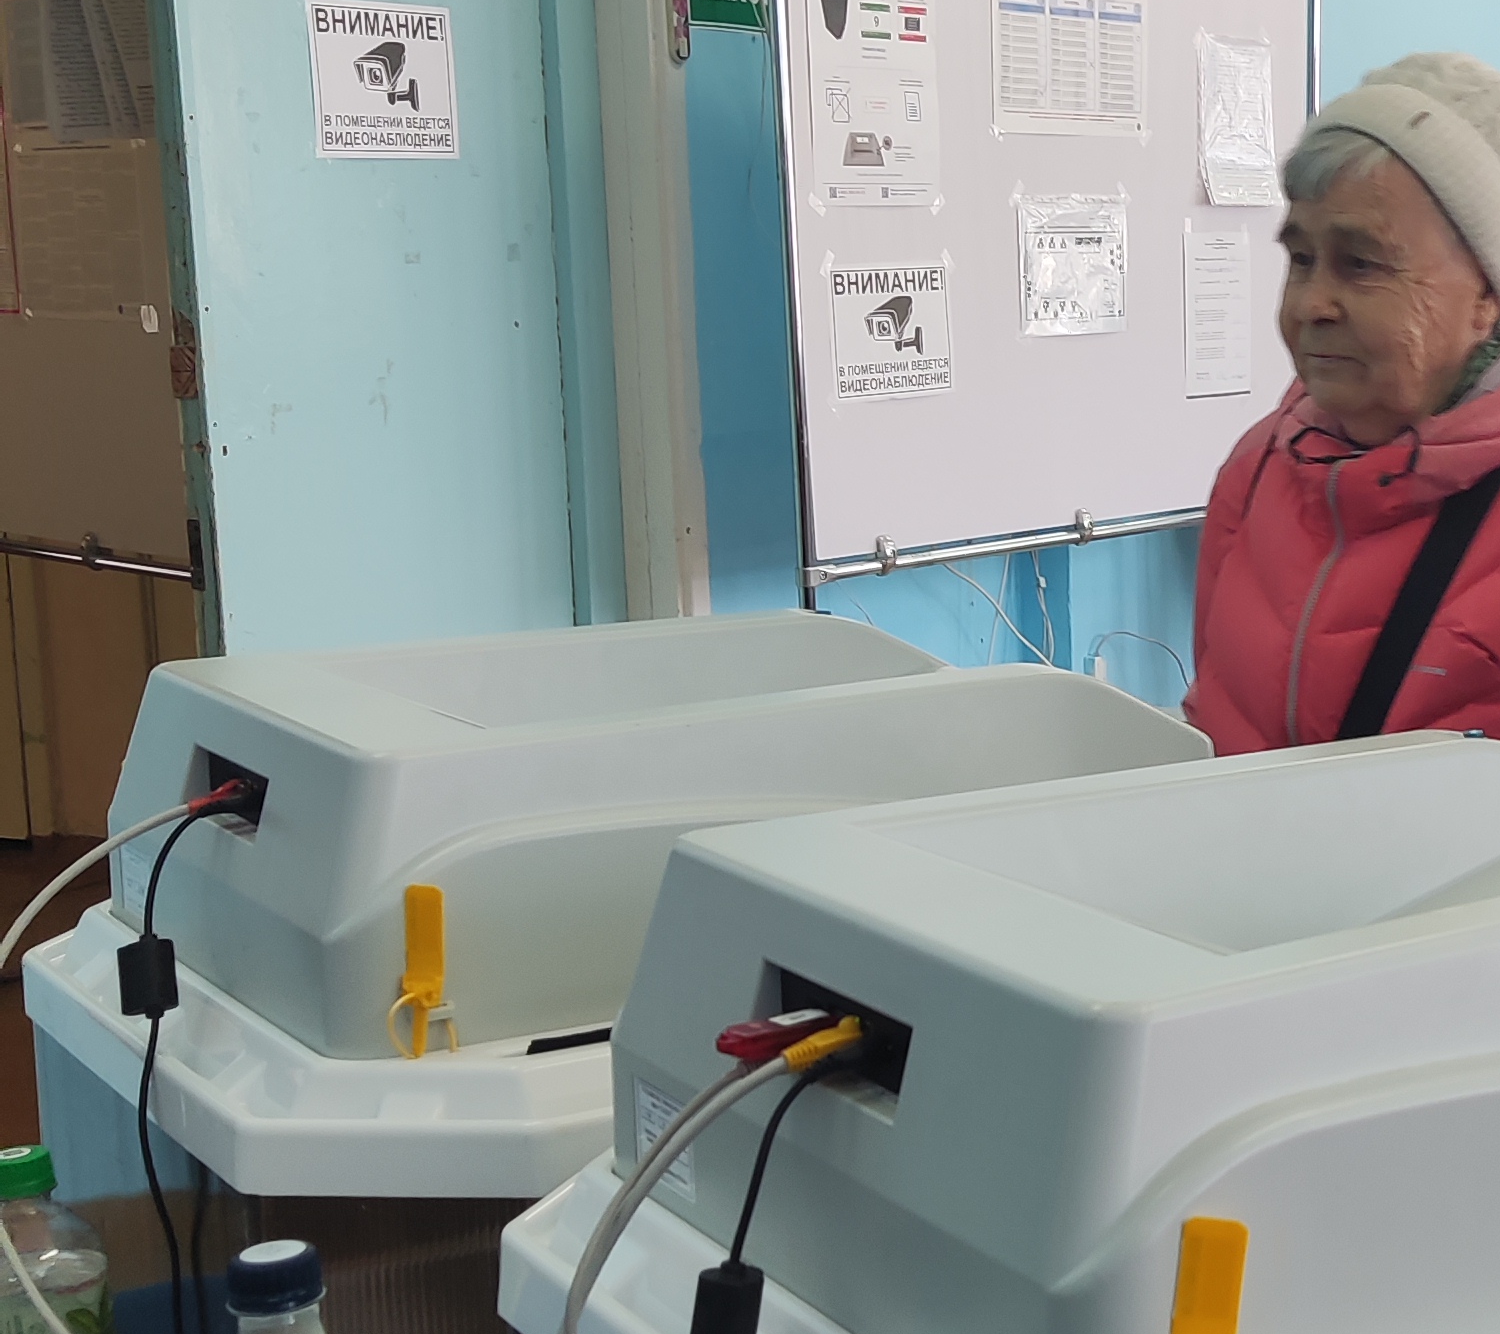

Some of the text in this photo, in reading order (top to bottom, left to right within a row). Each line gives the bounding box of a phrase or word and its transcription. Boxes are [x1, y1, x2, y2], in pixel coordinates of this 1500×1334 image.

[315, 8, 444, 41] ВНИМАНИЕ!
[324, 115, 450, 131] В ПОМЕЩЕНИИ ВЕДЕТСЯ
[325, 131, 452, 148] ВИДЕОНАБЛЮДЕНИЕ
[833, 270, 943, 295] ВНИМАНИЕ!
[839, 357, 949, 377] В ПОМЕЩЕНИИ ВЕДЕТСЯ
[840, 372, 950, 393] ВИДЕОНАБЛЮДЕНИЕ
